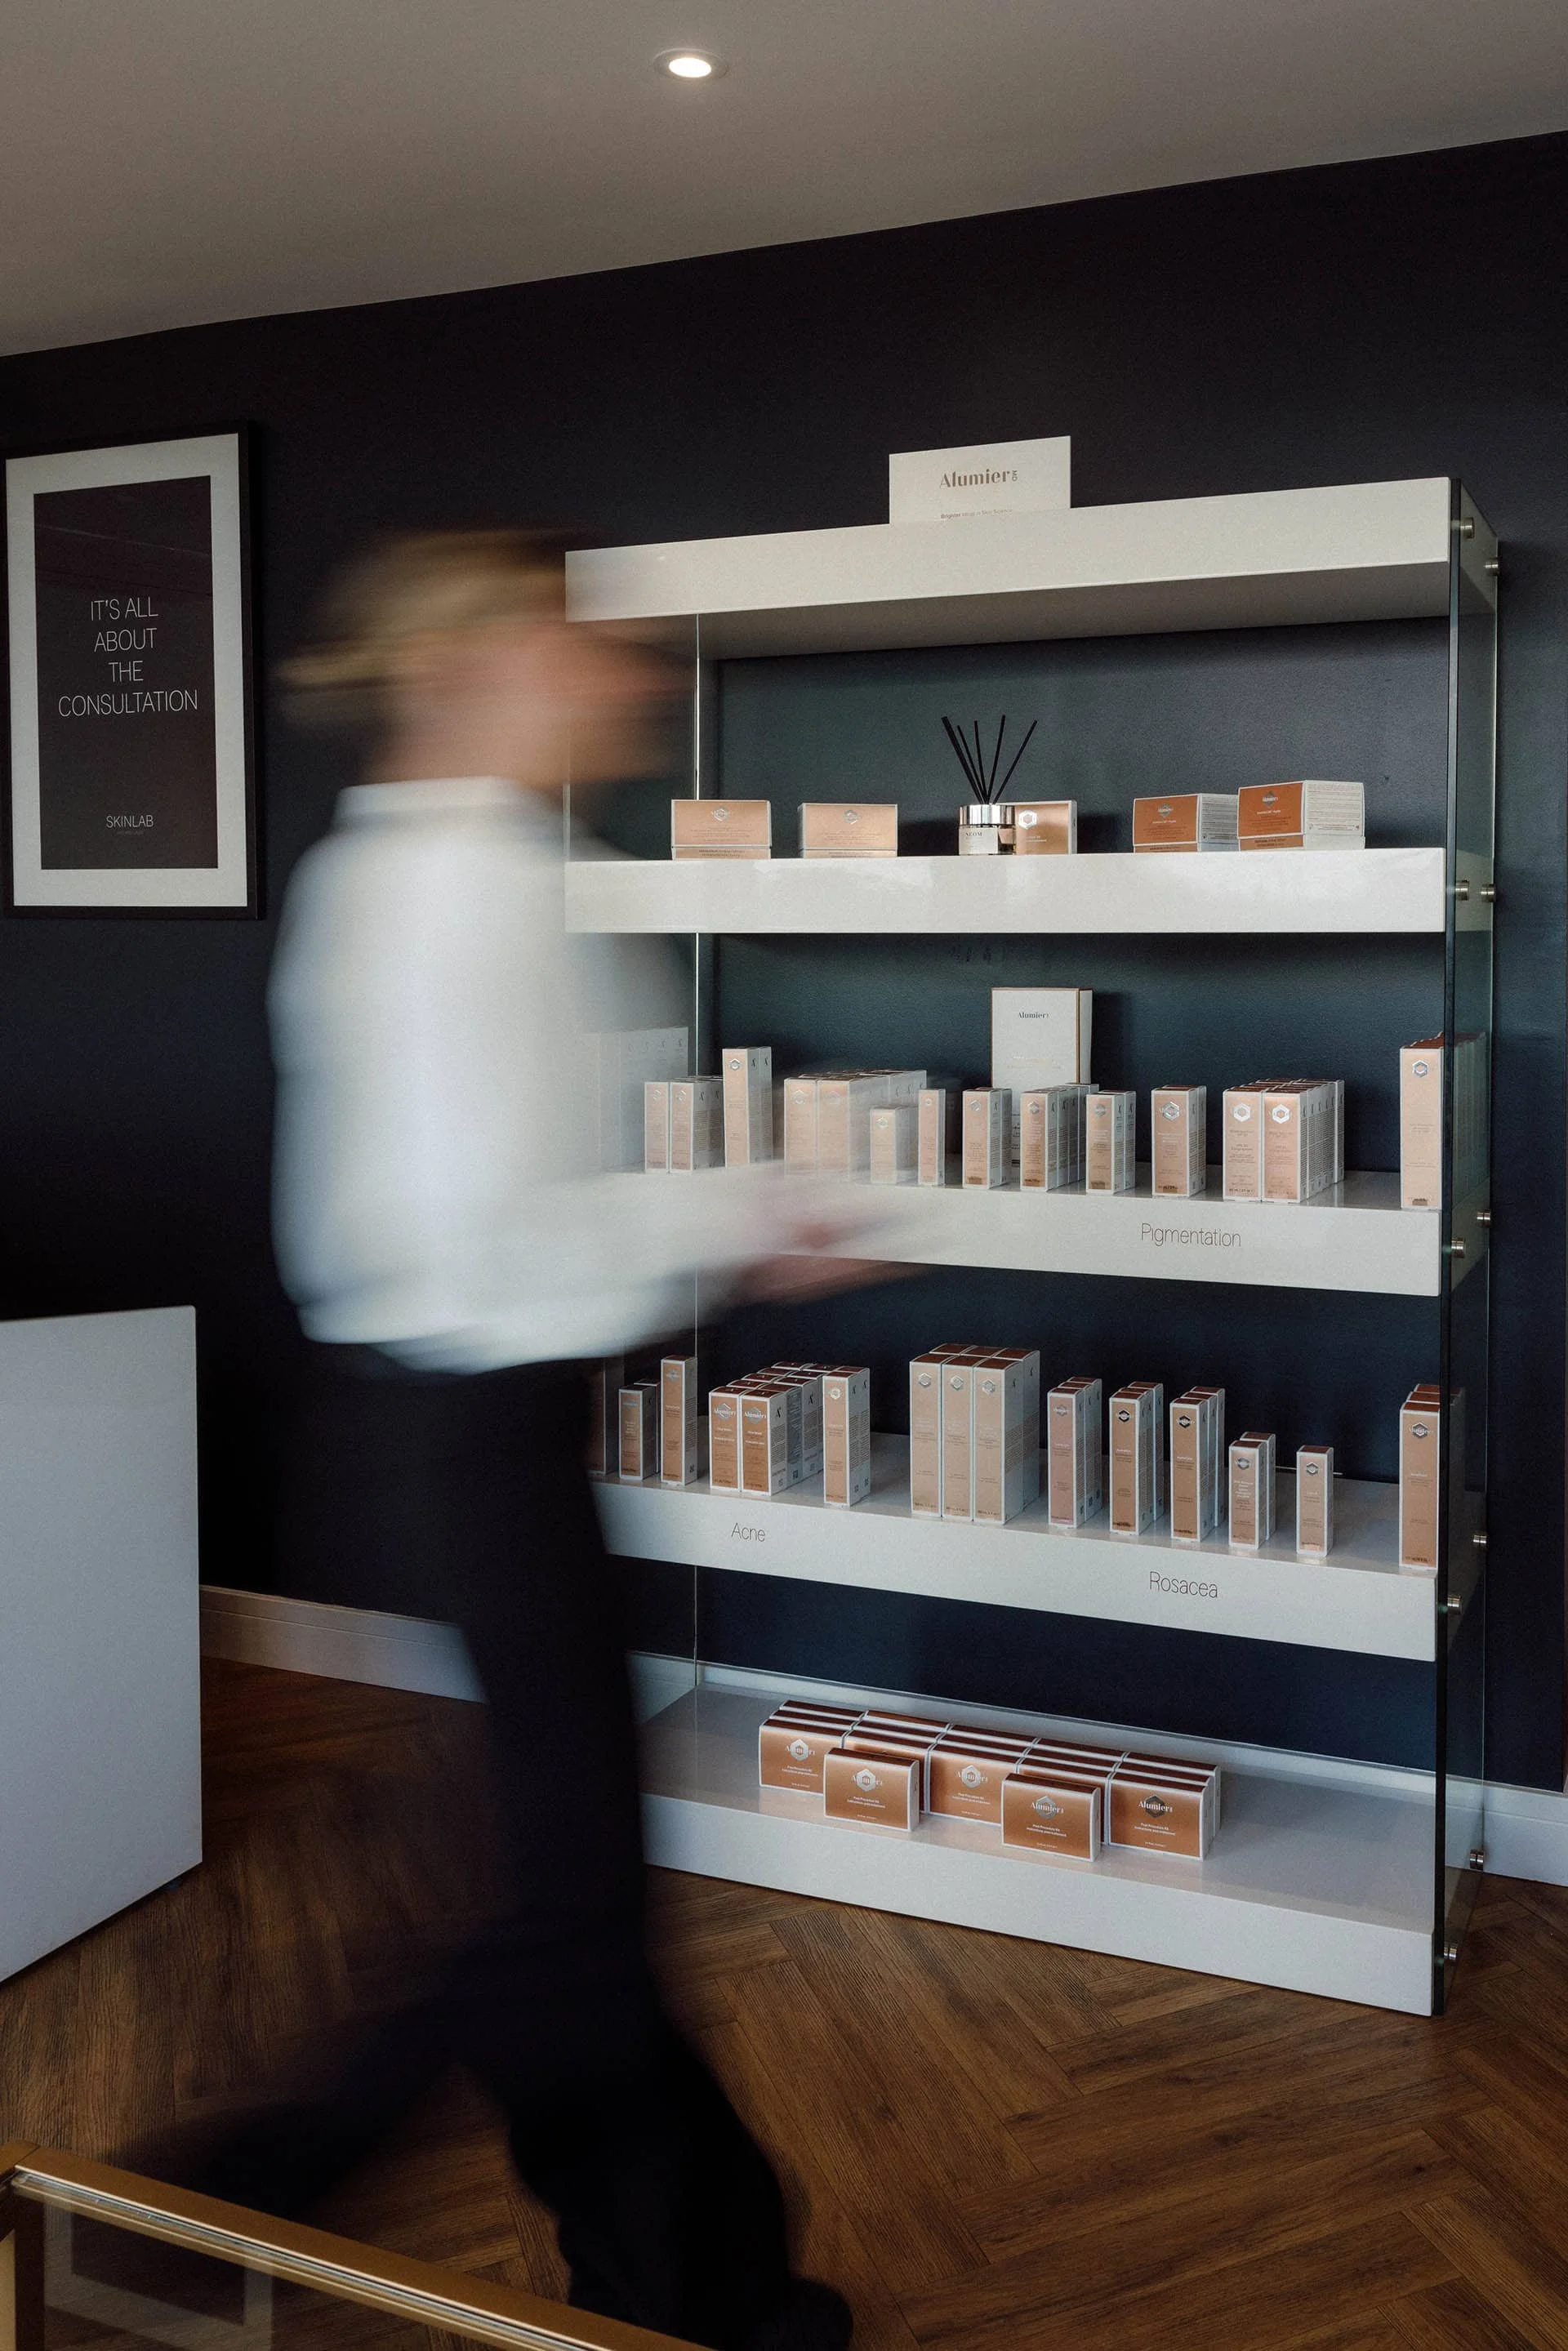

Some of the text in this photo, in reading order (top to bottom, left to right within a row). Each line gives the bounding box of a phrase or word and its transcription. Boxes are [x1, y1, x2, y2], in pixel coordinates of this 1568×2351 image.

[939, 468, 1010, 489] Alumier
[91, 595, 159, 621] IT'S ALL
[93, 627, 158, 652] ABOUT
[108, 660, 144, 682] THE
[58, 689, 198, 717] CONSULTATION
[105, 814, 154, 828] SKINLAB
[1140, 1222, 1242, 1247] Pigmentation
[731, 1522, 766, 1543] Acne
[1149, 1570, 1218, 1599] Rosacea
[1138, 1800, 1169, 1812] Alumier
